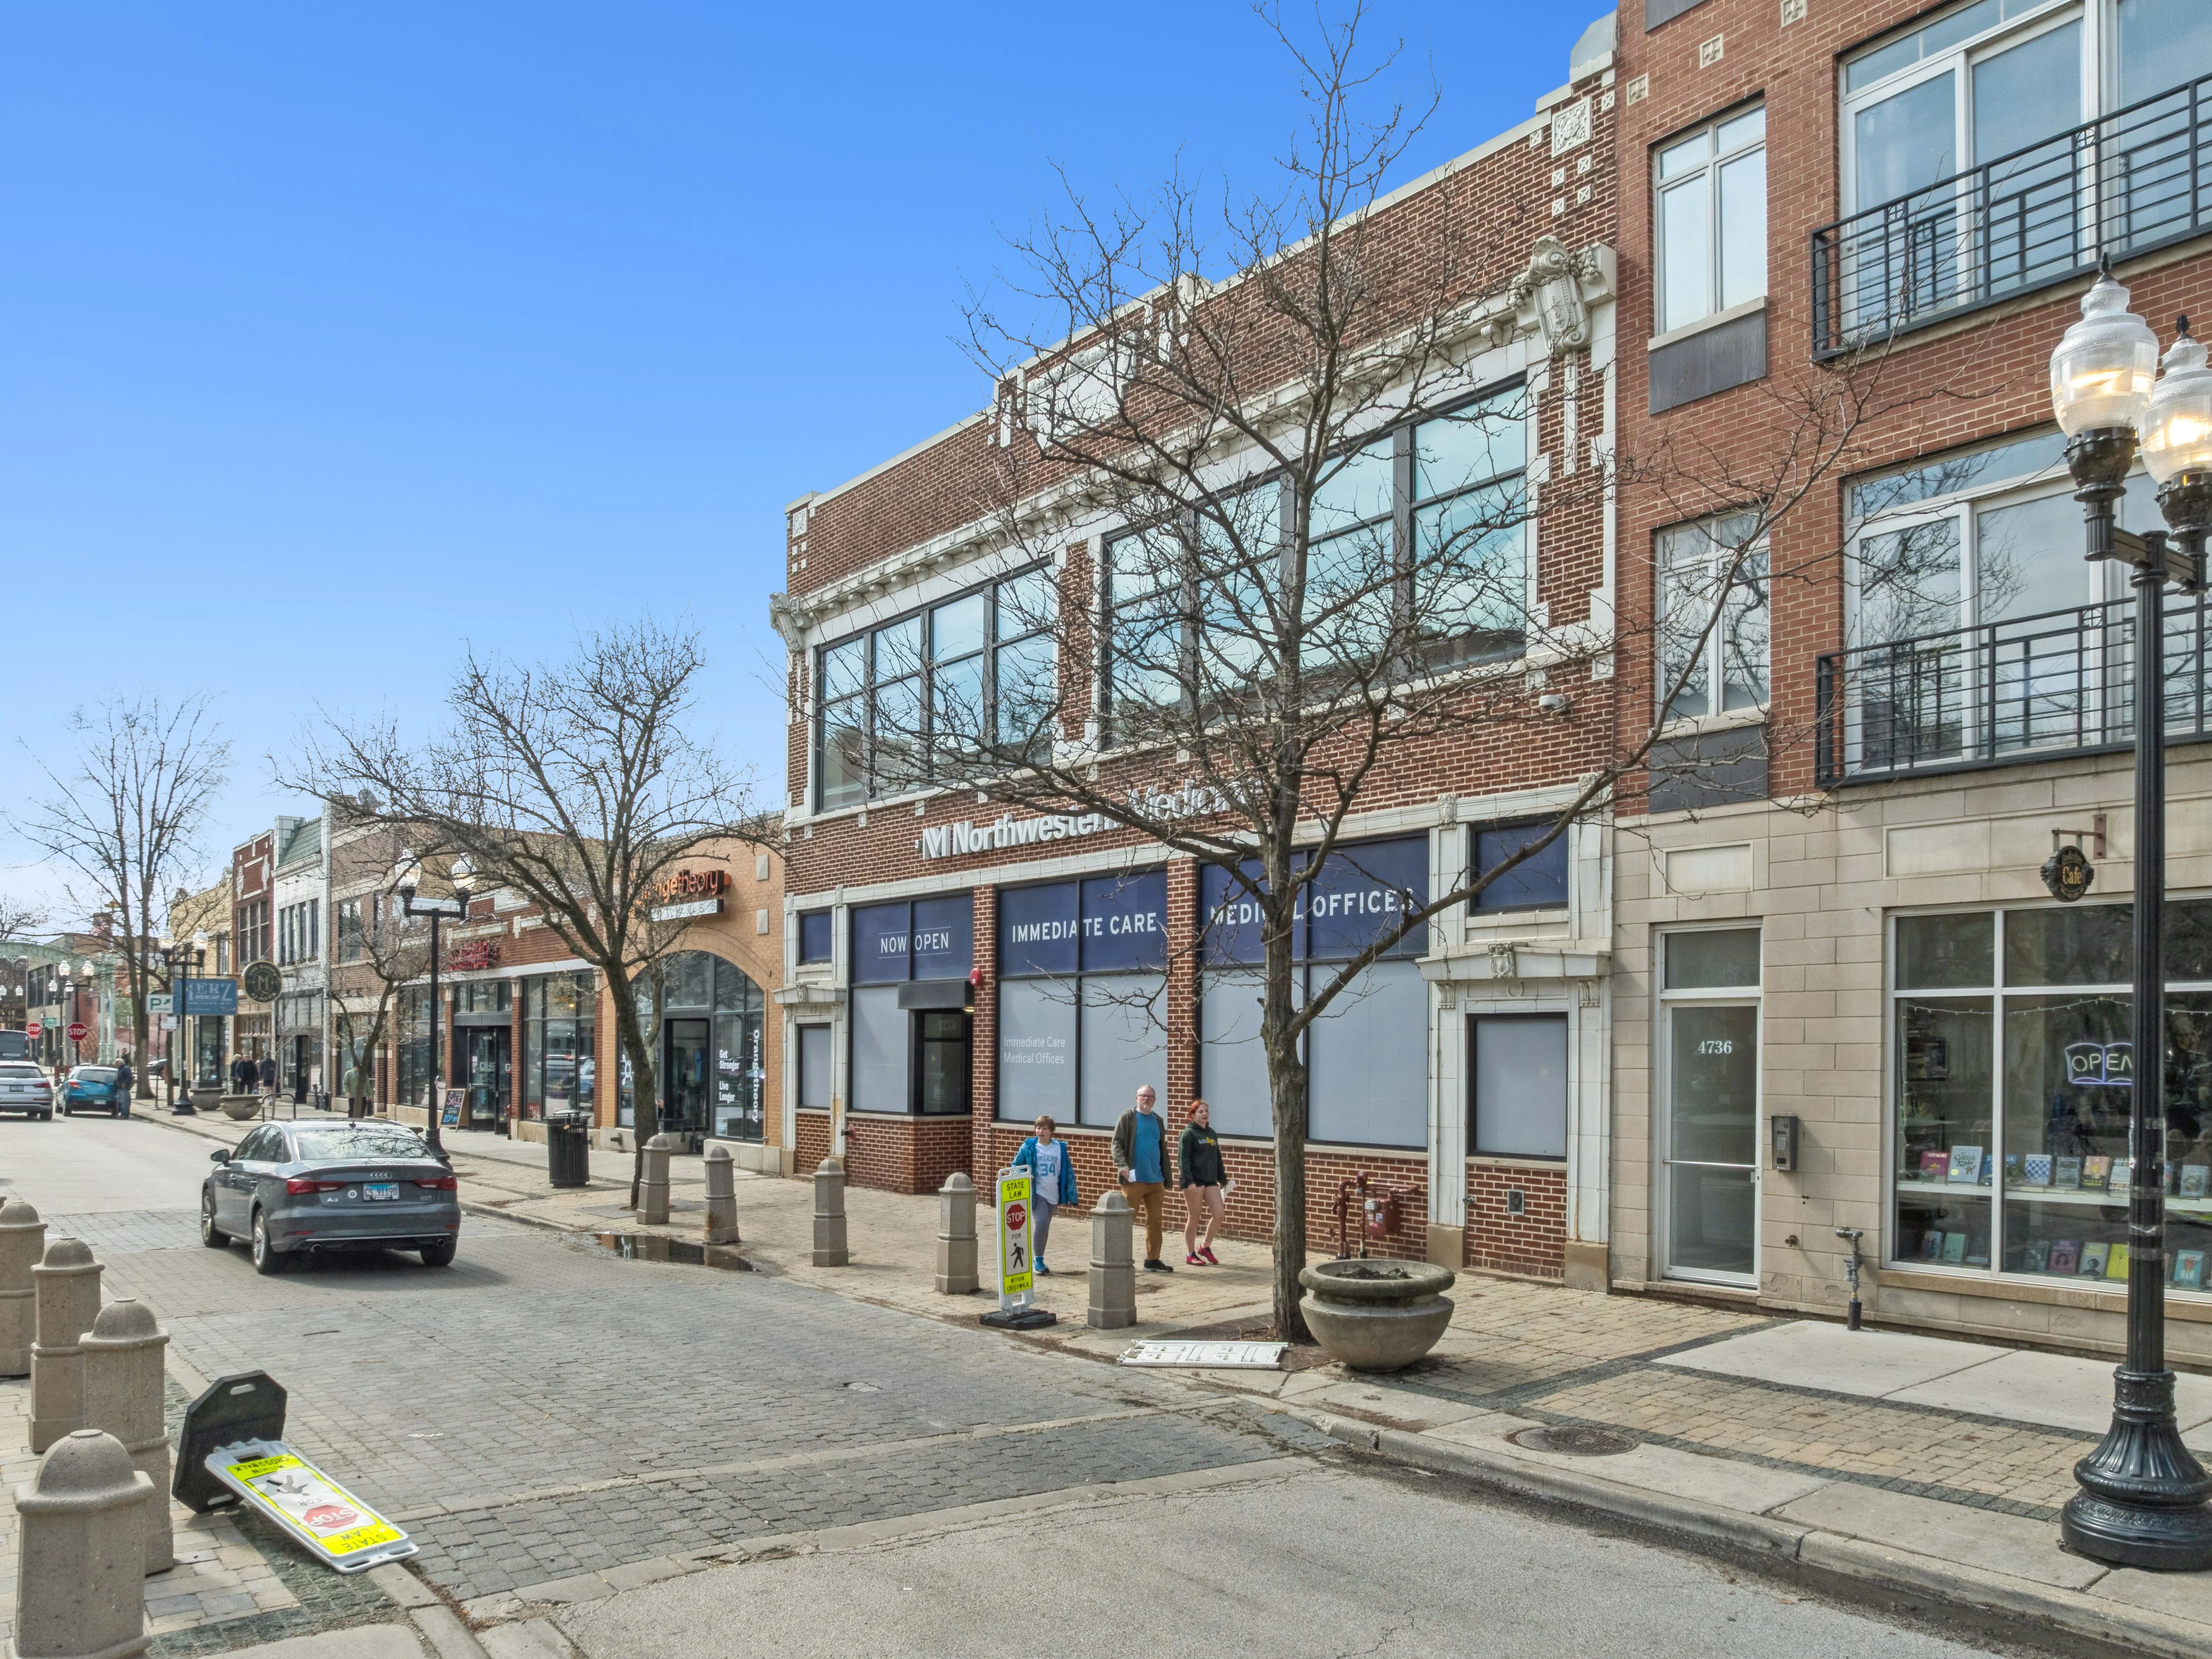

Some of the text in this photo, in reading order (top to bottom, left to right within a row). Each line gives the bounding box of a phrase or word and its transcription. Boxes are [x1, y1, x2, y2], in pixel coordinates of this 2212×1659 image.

[2062, 866, 2082, 884] Cafe
[1210, 900, 1304, 926] MEDIL
[1012, 912, 1156, 943] IMMEDIATE CARE
[881, 932, 948, 953] NOW OPEN
[249, 965, 277, 977] THE SHOPS
[1004, 1036, 1065, 1047] Immediate Care
[1698, 1040, 1732, 1054] 4736
[719, 1050, 728, 1059] Get
[1004, 1052, 1064, 1064] Medical Offices
[719, 1061, 740, 1072] Stronger
[2072, 1053, 2133, 1072] OPEN
[719, 1081, 729, 1090] Live
[447, 1095, 463, 1106] SALE
[719, 1092, 735, 1103] Longer
[1040, 1163, 1056, 1177] 34
[1007, 1181, 1024, 1191] STATE
[1009, 1190, 1022, 1199] LAW
[1007, 1211, 1025, 1224] STOP
[1011, 1275, 1024, 1284] WITHIN
[1007, 1281, 1029, 1292] CROSSWALK
[234, 1456, 289, 1472] CROSSWALK
[251, 1465, 284, 1474] WITHIN
[298, 1497, 322, 1506] FOR
[309, 1509, 356, 1526] STOP
[340, 1528, 372, 1541] LAW
[341, 1534, 387, 1551] STATE
